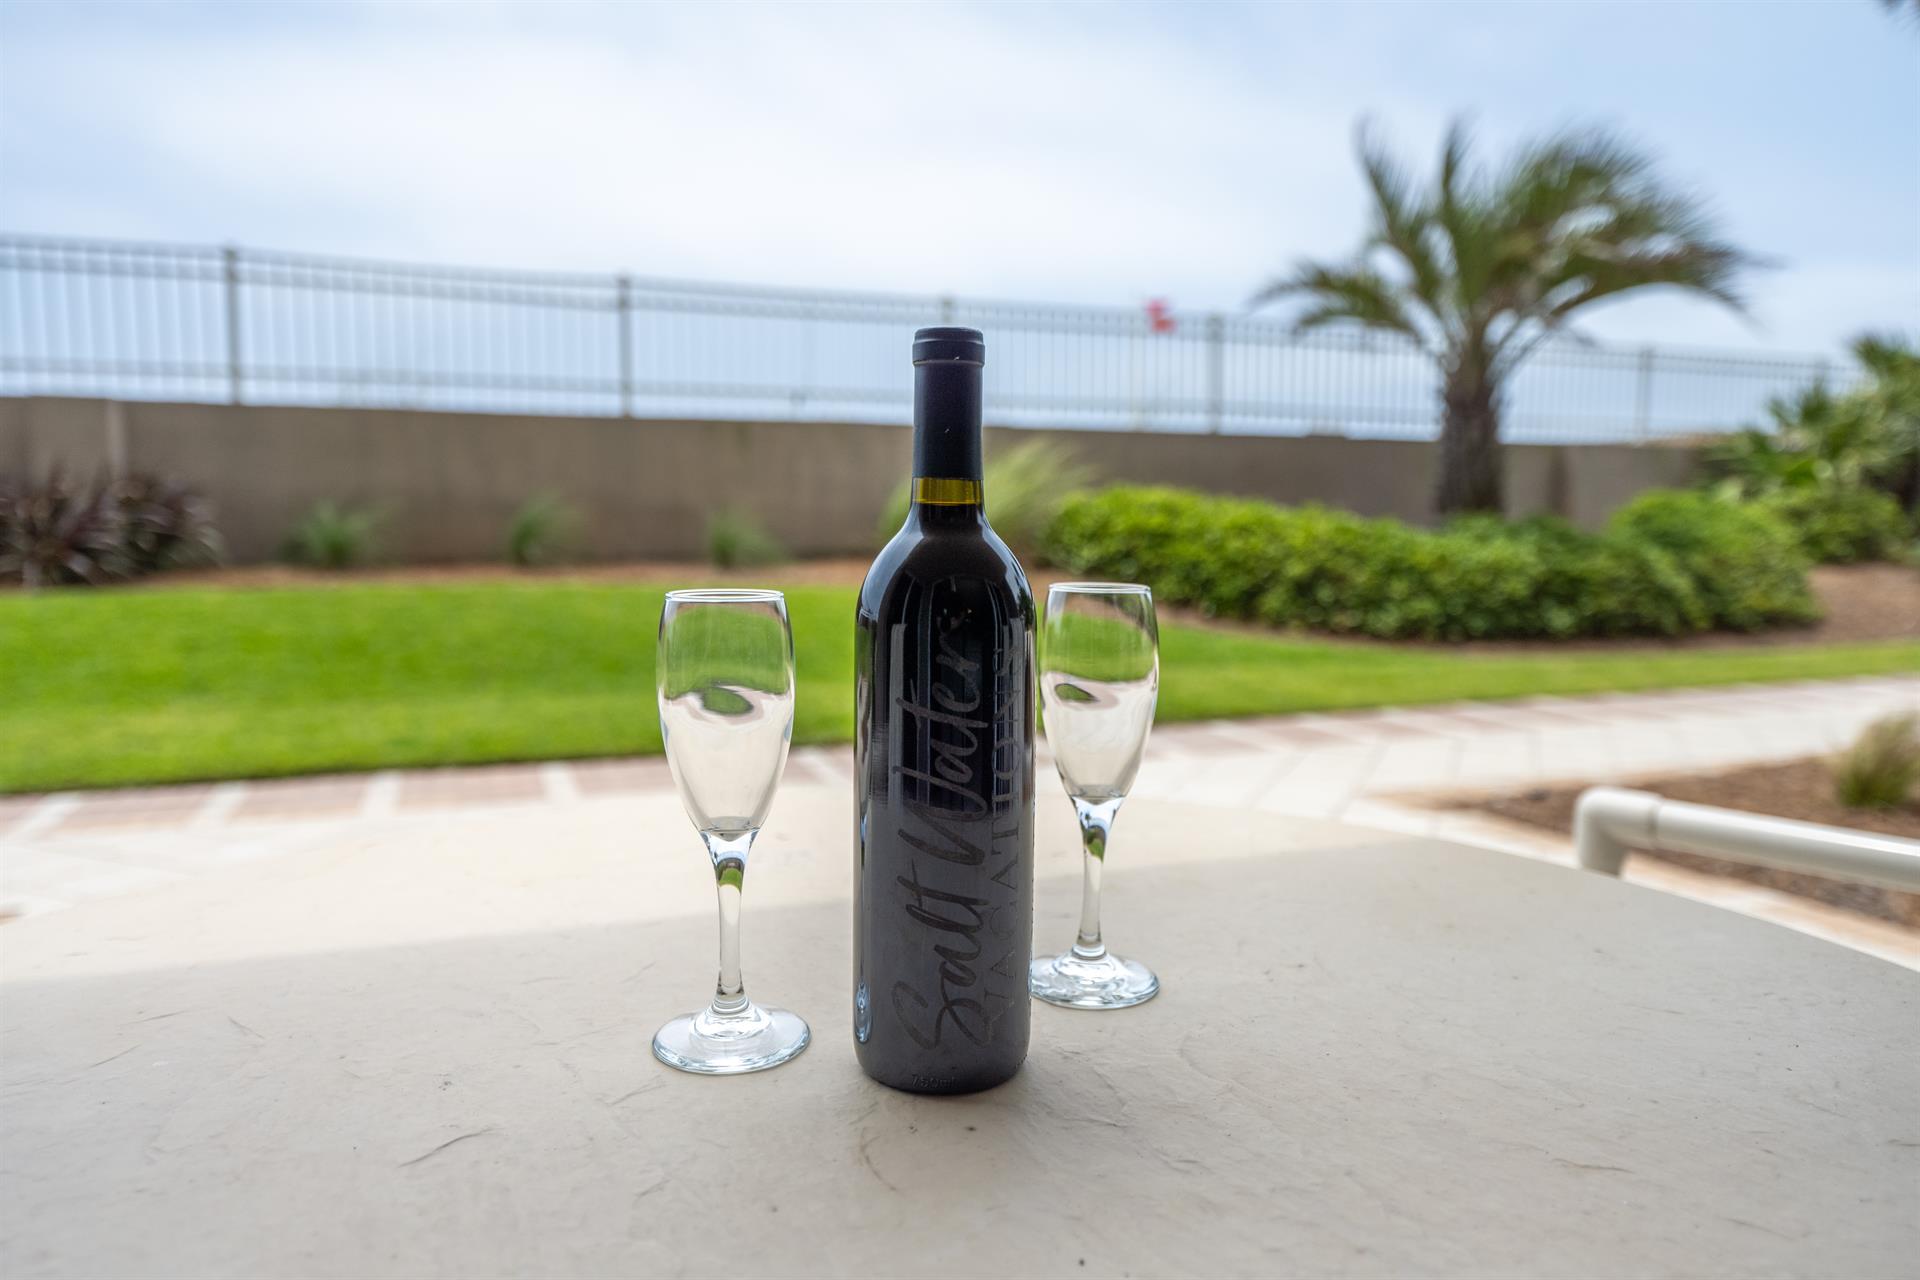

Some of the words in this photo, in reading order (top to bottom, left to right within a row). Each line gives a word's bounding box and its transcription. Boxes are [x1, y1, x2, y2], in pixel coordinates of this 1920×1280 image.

[892, 628, 988, 867] Water
[984, 648, 1020, 1042] VACATIONS
[892, 858, 993, 1050] Salt
